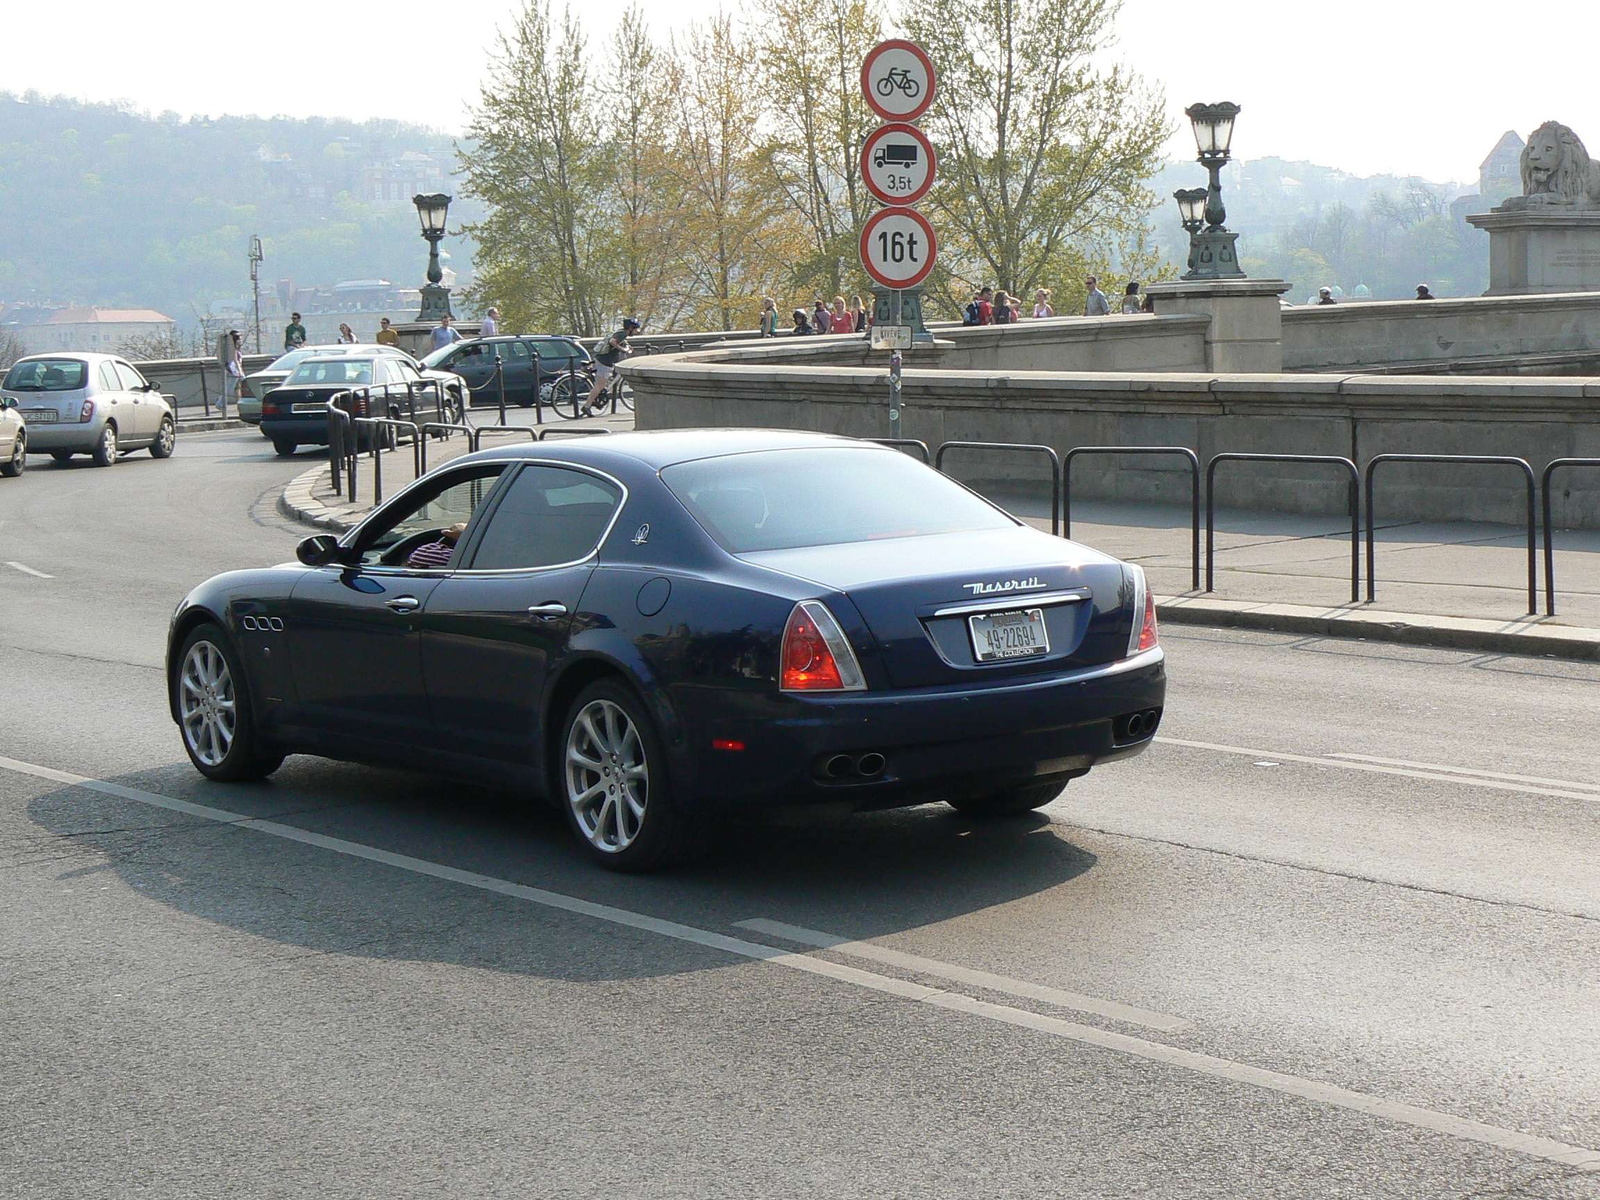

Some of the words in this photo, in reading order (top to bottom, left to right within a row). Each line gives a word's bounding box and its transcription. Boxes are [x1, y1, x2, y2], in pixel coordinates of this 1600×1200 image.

[887, 174, 912, 191] 3,5t
[878, 231, 918, 263] 16t
[962, 576, 1047, 595] Maserati
